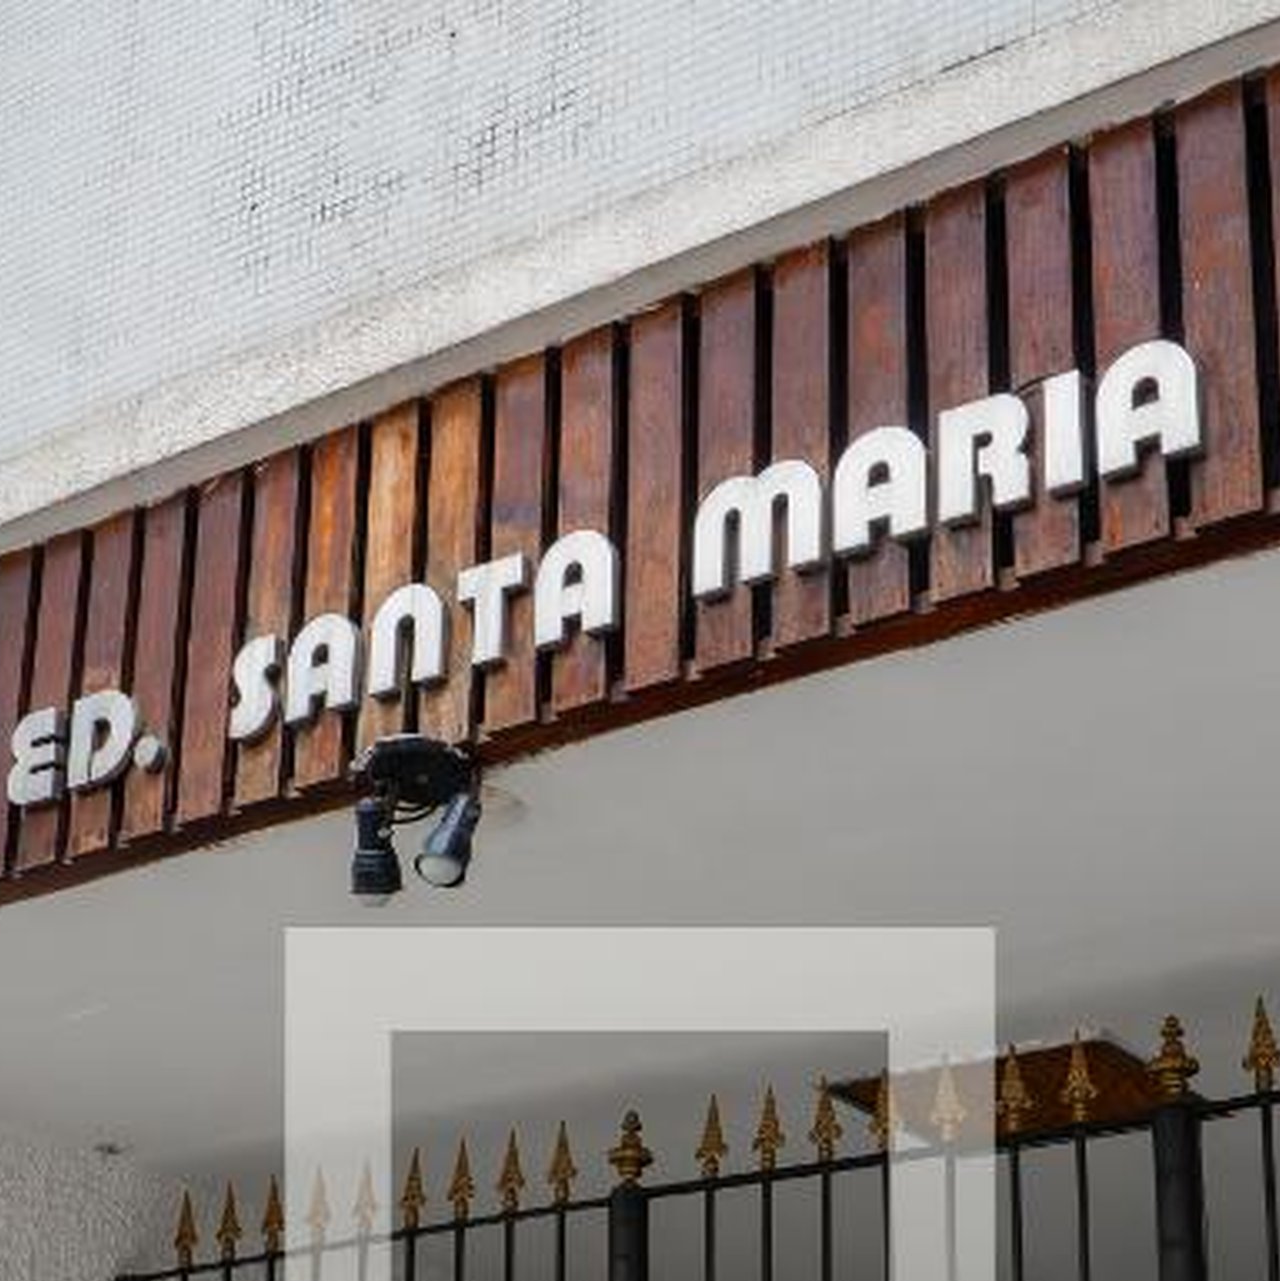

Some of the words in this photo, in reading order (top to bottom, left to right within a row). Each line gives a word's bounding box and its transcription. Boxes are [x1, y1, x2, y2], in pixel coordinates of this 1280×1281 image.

[7, 689, 167, 806] ED.
[228, 528, 621, 743] SANTA
[692, 339, 1206, 605] MARIA
